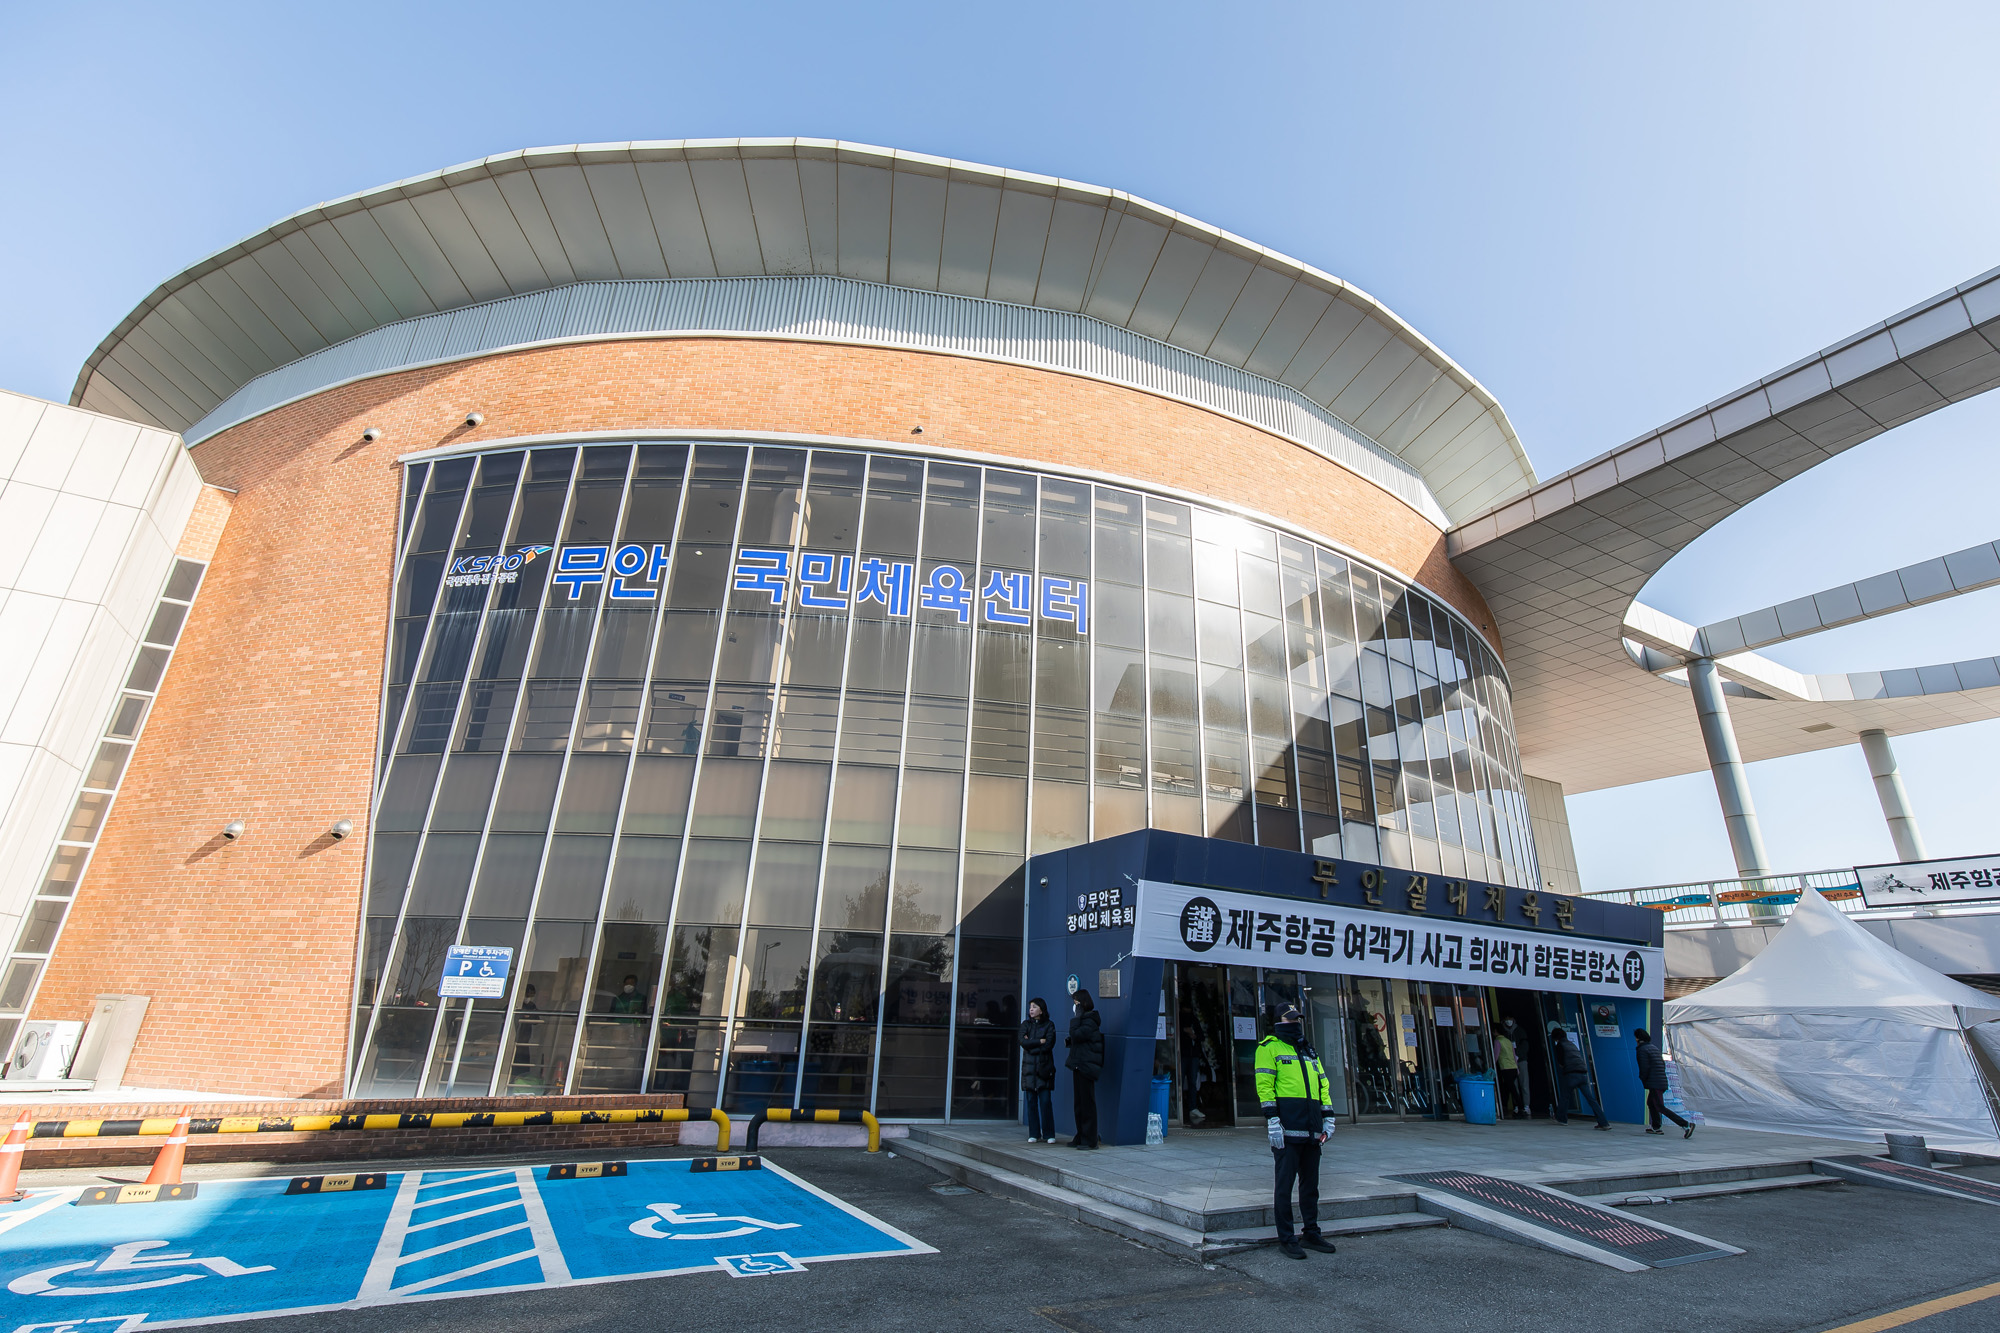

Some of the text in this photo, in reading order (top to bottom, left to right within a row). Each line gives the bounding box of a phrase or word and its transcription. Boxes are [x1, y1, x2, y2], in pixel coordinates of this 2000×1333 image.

[449, 554, 524, 575] KSPO
[552, 544, 1088, 635] 무안 국민체육센터
[1088, 888, 1121, 909] 무안군
[1312, 859, 1577, 930] 무안실내체육관
[1186, 904, 1217, 944] 謹
[1225, 908, 1336, 958] 제주항공
[1343, 922, 1415, 966] 여객기
[1420, 932, 1463, 970] 사고
[1468, 936, 1529, 977] 희생자
[1533, 944, 1620, 985] 합동분향소
[459, 961, 473, 976] P
[127, 1189, 152, 1198] STOP
[327, 1179, 349, 1187] STOP
